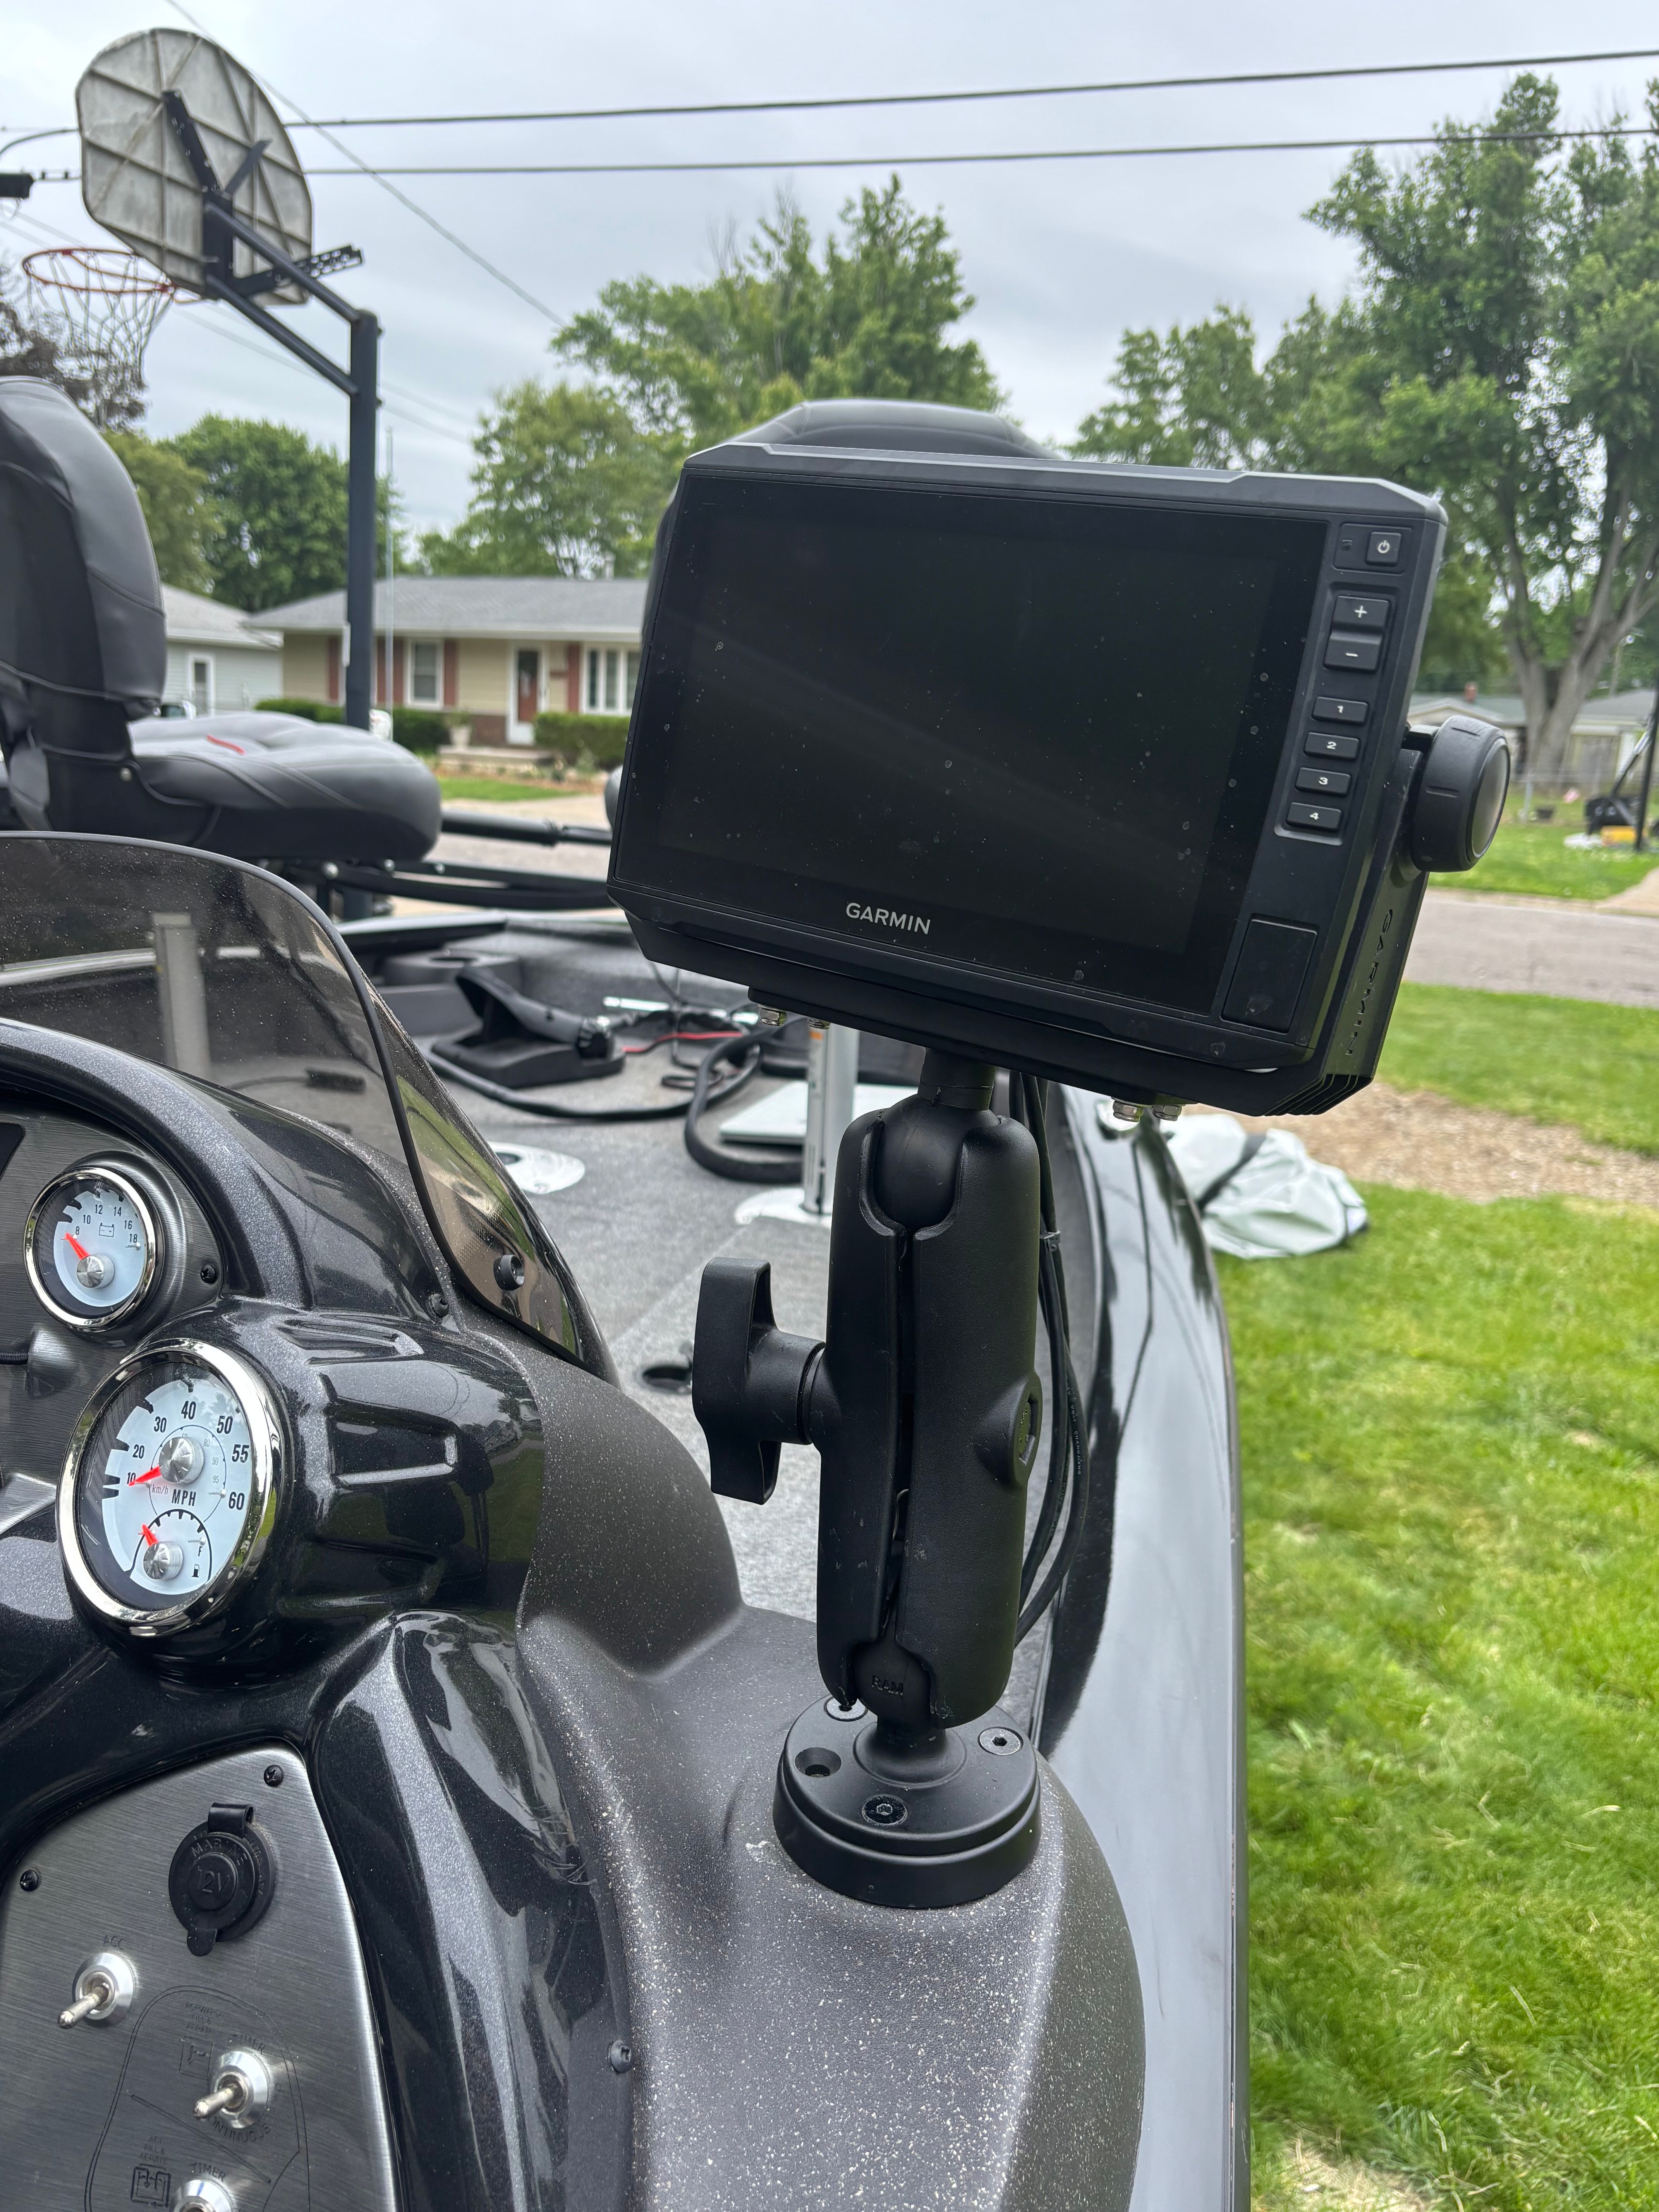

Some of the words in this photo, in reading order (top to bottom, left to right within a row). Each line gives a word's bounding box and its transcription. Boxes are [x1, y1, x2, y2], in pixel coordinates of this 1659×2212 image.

[1336, 705, 1344, 713] 1
[1326, 741, 1336, 750] 2
[1318, 777, 1328, 785] 3
[1310, 812, 1319, 820] 4
[846, 902, 931, 935] GARMIN
[95, 1204, 103, 1215] 12
[114, 1206, 122, 1217] 14
[83, 1214, 91, 1224] 10
[124, 1220, 132, 1230] 16
[75, 1226, 80, 1235] 8
[130, 1233, 138, 1243] 18
[181, 1400, 197, 1420] 40
[154, 1416, 167, 1433] 30
[216, 1415, 233, 1434] 50
[203, 1439, 210, 1447] 80
[133, 1444, 145, 1459] 20
[232, 1444, 250, 1463] 55
[212, 1457, 219, 1465] 90
[127, 1472, 136, 1485] 10
[213, 1475, 219, 1484] 95
[152, 1484, 169, 1495] km/h
[171, 1488, 197, 1506] MPH
[228, 1491, 246, 1511] 60
[198, 1546, 203, 1557] F
[871, 1675, 904, 1695] RAM
[191, 1838, 248, 1866] MARINE
[197, 1866, 230, 1894] 12V
[103, 1934, 126, 1950] ACC
[233, 2033, 266, 2054] TIMER
[209, 2116, 271, 2143] ONTINUOUS
[190, 2162, 226, 2182] TIMER
